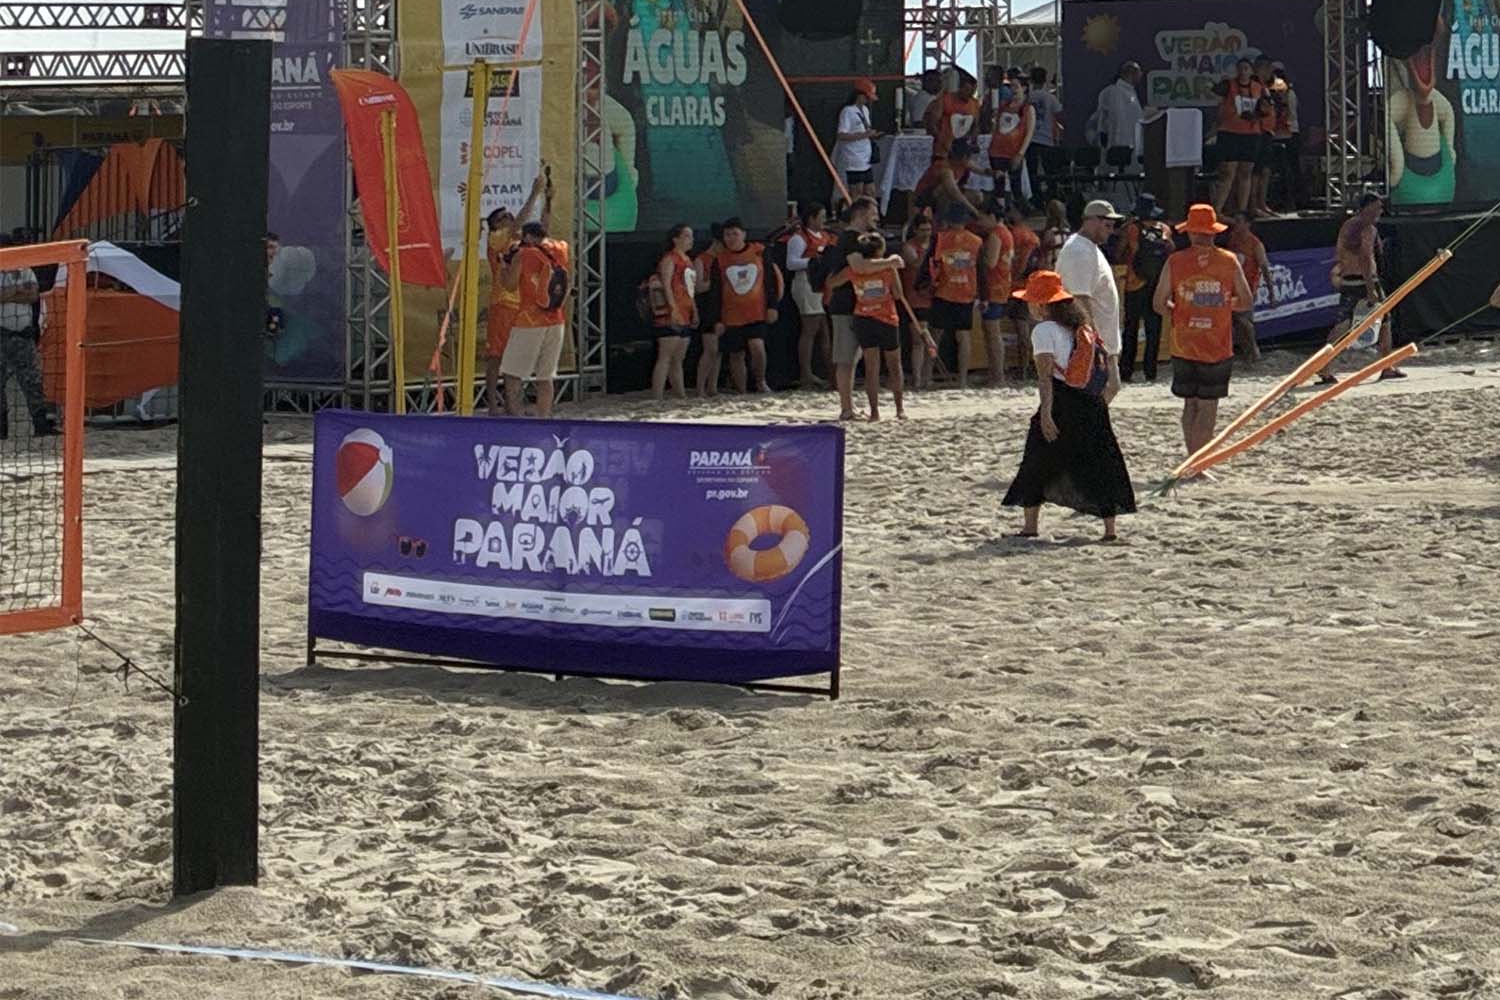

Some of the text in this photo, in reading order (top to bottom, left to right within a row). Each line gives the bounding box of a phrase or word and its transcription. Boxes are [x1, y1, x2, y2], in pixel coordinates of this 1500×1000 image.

[622, 14, 748, 86] ÁGUAS
[1177, 54, 1238, 74] MAIO
[1152, 76, 1215, 98] PAR
[646, 95, 727, 127] CLARAS
[482, 184, 522, 194] ATAM
[474, 433, 595, 486] VERÃO
[690, 447, 753, 467] PARANÁ
[491, 481, 616, 526] MAIOR
[705, 487, 749, 500] pr.gov.br
[453, 516, 652, 577] PARANÁ
